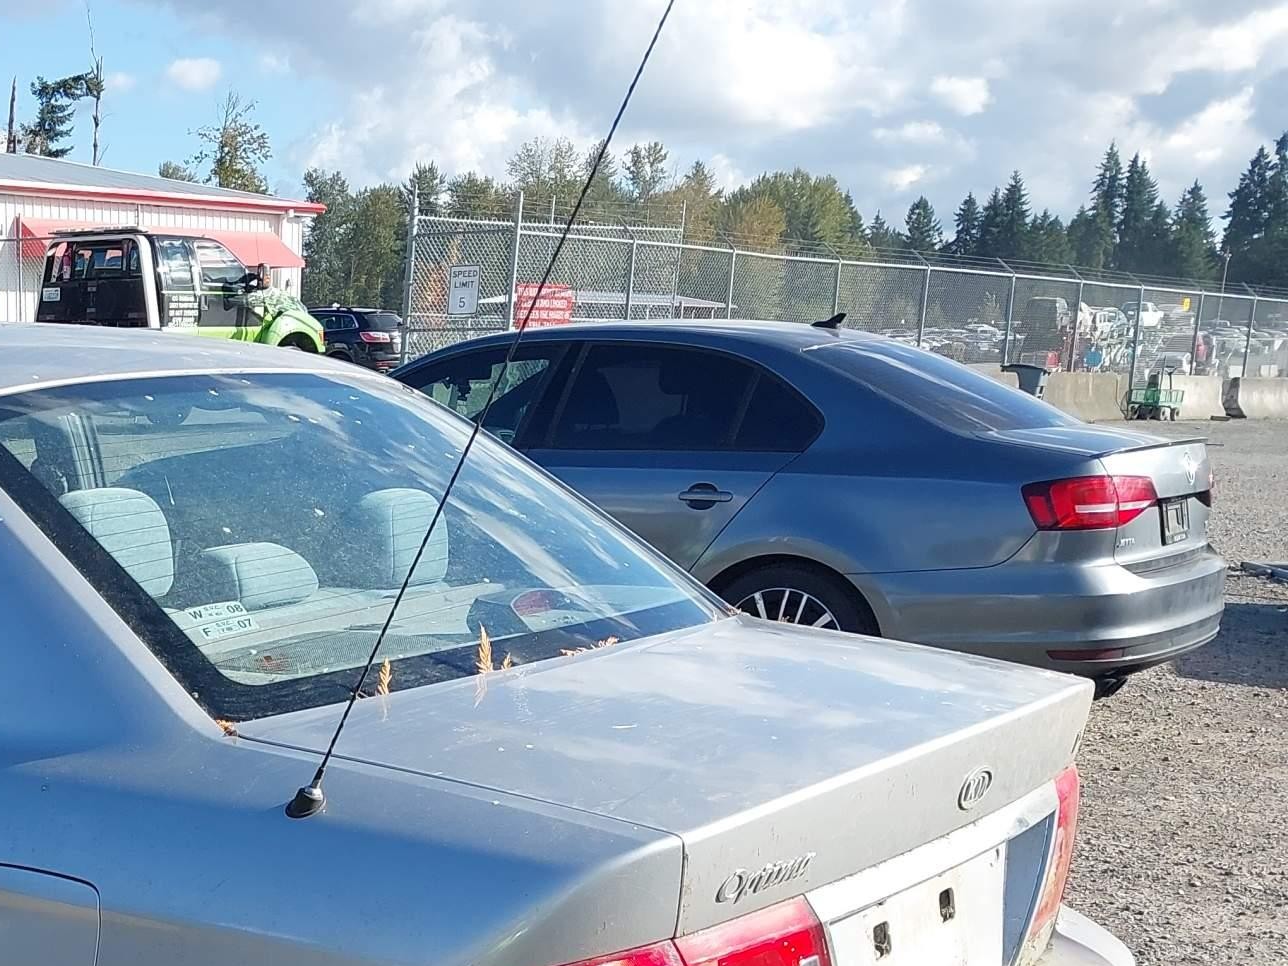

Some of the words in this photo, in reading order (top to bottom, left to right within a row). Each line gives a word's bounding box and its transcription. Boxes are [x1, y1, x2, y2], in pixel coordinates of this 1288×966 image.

[452, 269, 478, 279] SPEED
[454, 280, 475, 289] LIMIT
[458, 296, 466, 309] 5
[188, 610, 203, 620] W
[226, 604, 244, 614] 08
[202, 627, 211, 637] F
[237, 618, 252, 629] 07
[715, 852, 816, 905] Optima
